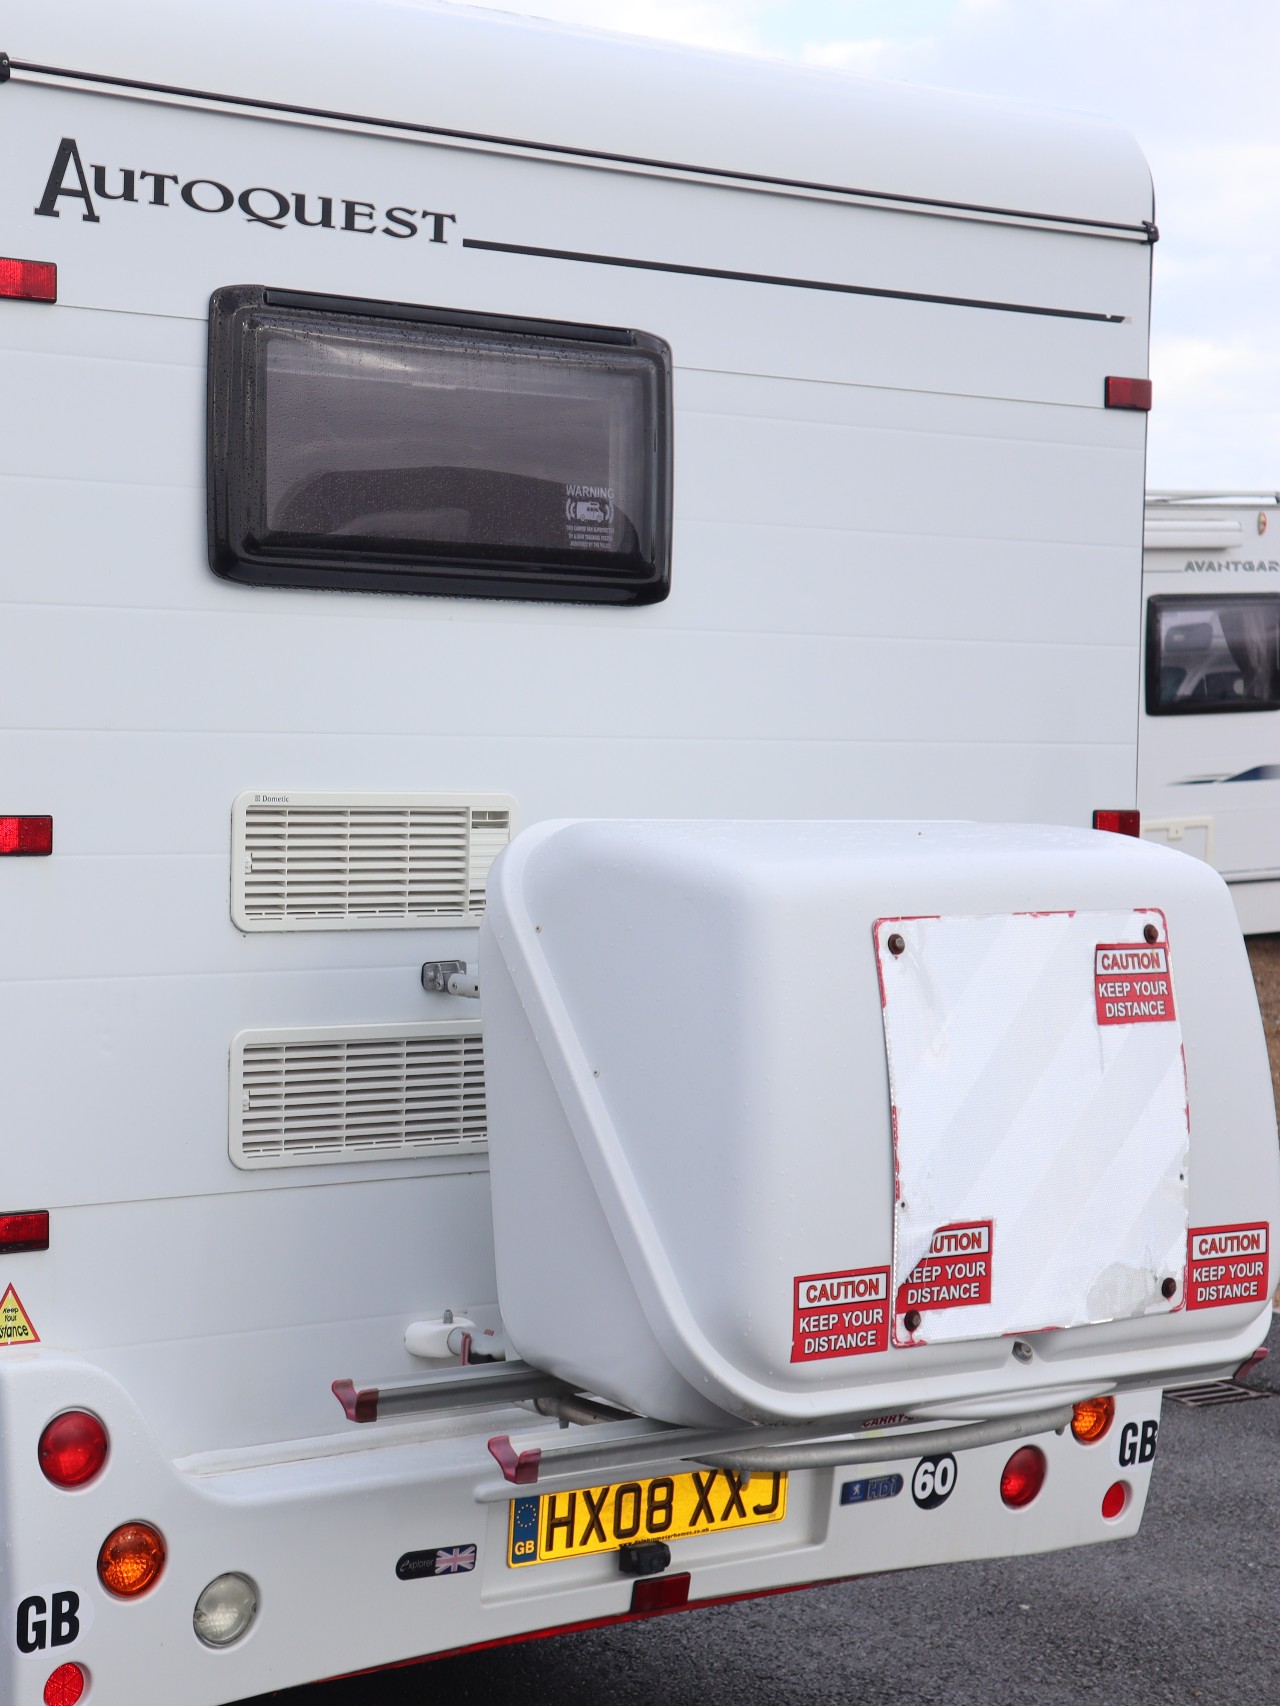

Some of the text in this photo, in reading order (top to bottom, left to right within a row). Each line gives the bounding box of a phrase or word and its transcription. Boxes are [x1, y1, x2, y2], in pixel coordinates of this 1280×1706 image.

[33, 137, 456, 245] AUTOQUEST
[565, 485, 615, 499] WARNING
[262, 795, 290, 803] Dometic
[1101, 952, 1161, 971] CAUTION
[1098, 980, 1169, 998] KEEP YOUR
[1105, 1000, 1166, 1018] DISTANCE
[929, 1232, 982, 1254] UTION
[1198, 1233, 1261, 1256] CAUTION
[945, 1261, 986, 1280] YOUR
[1193, 1261, 1264, 1283] KEEP YOUR
[806, 1278, 880, 1303] CAUTION
[907, 1282, 980, 1305] DISTANCE
[1197, 1281, 1258, 1302] DISTANCE
[799, 1308, 883, 1334] KEEP YOUR
[804, 1330, 877, 1354] DISTANCE
[1119, 1420, 1159, 1468] GB
[914, 1457, 955, 1500] 60
[545, 1469, 781, 1552] HX08 XXJ
[514, 1540, 535, 1556] GB
[399, 1559, 434, 1573] explorer
[17, 1590, 80, 1654] GB
